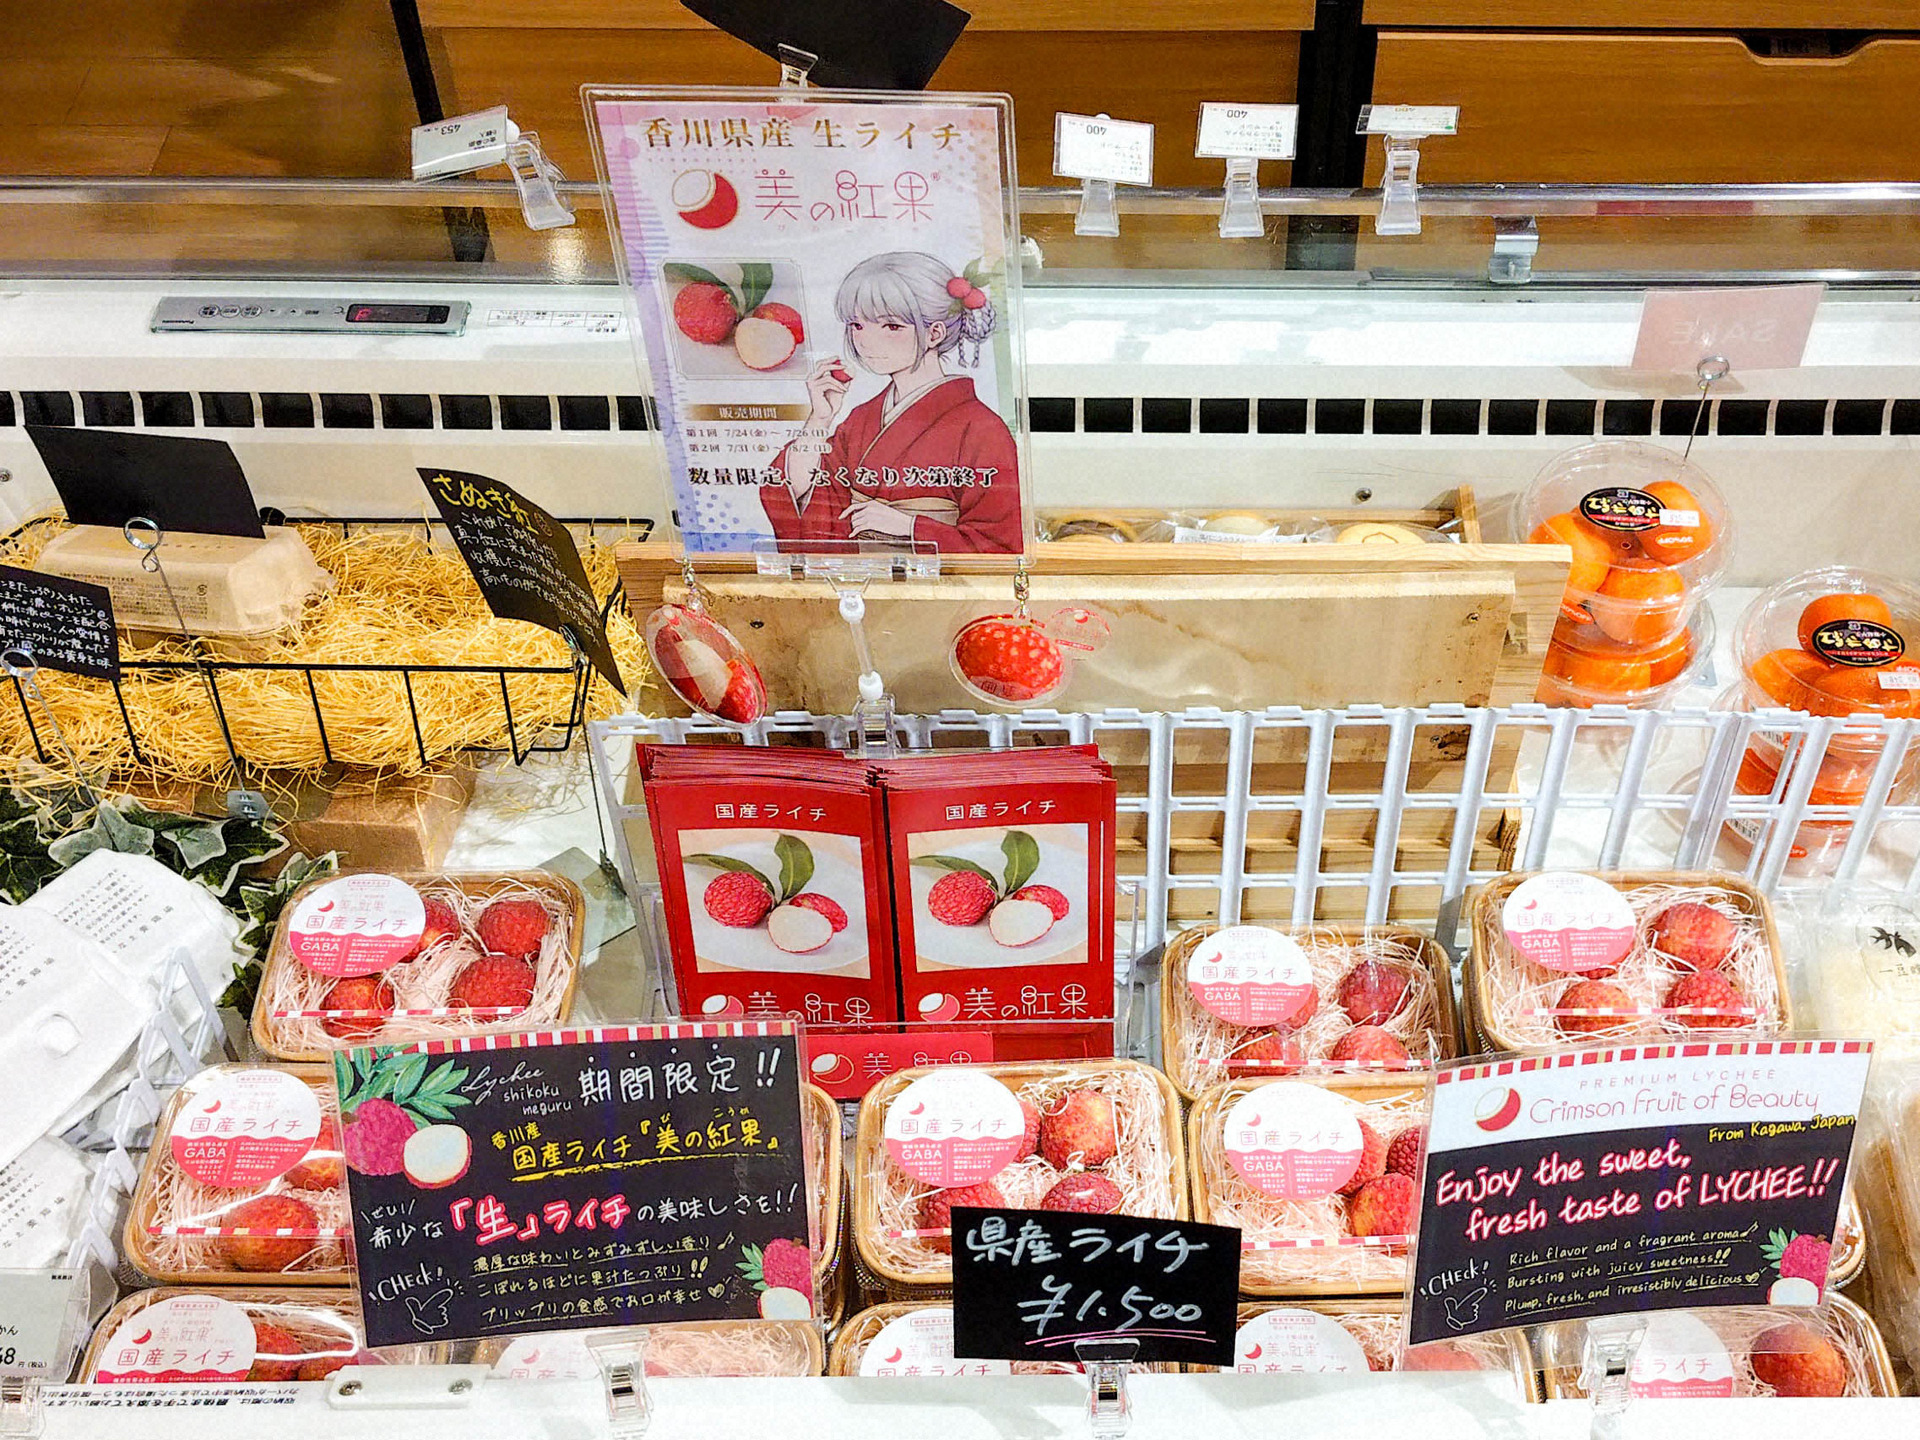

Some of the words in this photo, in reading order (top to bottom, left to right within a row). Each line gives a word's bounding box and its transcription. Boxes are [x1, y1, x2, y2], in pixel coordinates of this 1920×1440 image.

[1227, 110, 1248, 119] 400
[643, 117, 794, 149] 香川県産
[813, 117, 963, 150] 生ライチ
[1086, 125, 1107, 135] 400
[754, 169, 934, 222] 美の紅果
[719, 406, 778, 419] 販売期間
[687, 466, 998, 487] 数量限定、なくなり次第終了
[715, 802, 828, 821] 国産ライチ
[945, 799, 1058, 821] 国産ライチ
[305, 915, 407, 932] 国産ライチ
[300, 942, 340, 952] GABA
[1521, 939, 1560, 949] GABA
[1202, 966, 1296, 980] 国産ライチ
[963, 982, 1089, 1019] 美の紅果
[1204, 991, 1242, 1001] GABA
[461, 1061, 545, 1106] Lychee
[1579, 1073, 1678, 1089] PREMIUM
[1693, 1068, 1777, 1083] LYCHEE
[503, 1084, 560, 1102] shikoku
[522, 1101, 572, 1117] meguru
[1529, 1097, 1625, 1125] Crimson
[1632, 1088, 1688, 1114] Fruit
[1693, 1084, 1725, 1110] of
[1729, 1083, 1820, 1112] Beauty
[190, 1117, 302, 1133] 国産ライチ
[901, 1118, 1007, 1134] 国産ライチ
[1708, 1126, 1745, 1144] From
[1750, 1121, 1807, 1141] Kagawa,
[1812, 1113, 1855, 1132] Japan
[491, 1122, 542, 1150] 香川産
[1240, 1130, 1344, 1146] 国産ライチ
[184, 1147, 226, 1158] GABA
[902, 1149, 942, 1160] GABA
[1243, 1161, 1285, 1172] GABA
[1437, 1163, 1522, 1206] Enjoy
[1534, 1149, 1584, 1186] the
[1600, 1139, 1692, 1173] sweet,
[1464, 1201, 1548, 1242] fresh
[1559, 1187, 1641, 1223] taste
[1654, 1175, 1693, 1212] of
[1699, 1158, 1840, 1206] LYCHEE!!
[966, 1216, 1210, 1273] 県産ライチ
[1509, 1249, 1539, 1266] Rich
[1546, 1245, 1588, 1261] flavor
[1595, 1240, 1617, 1253] and
[1623, 1241, 1631, 1250] a
[1637, 1231, 1696, 1249] fragrant
[1702, 1230, 1740, 1241] aroma
[1507, 1271, 1565, 1290] Bursting
[1571, 1264, 1600, 1280] with
[1608, 1259, 1643, 1277] juicy
[1547, 1291, 1584, 1308] fresh,
[1588, 1286, 1610, 1298] and
[1617, 1278, 1682, 1297] irresistibly
[1685, 1274, 1743, 1289] delicious
[118, 1348, 235, 1366] 国産ライチ
